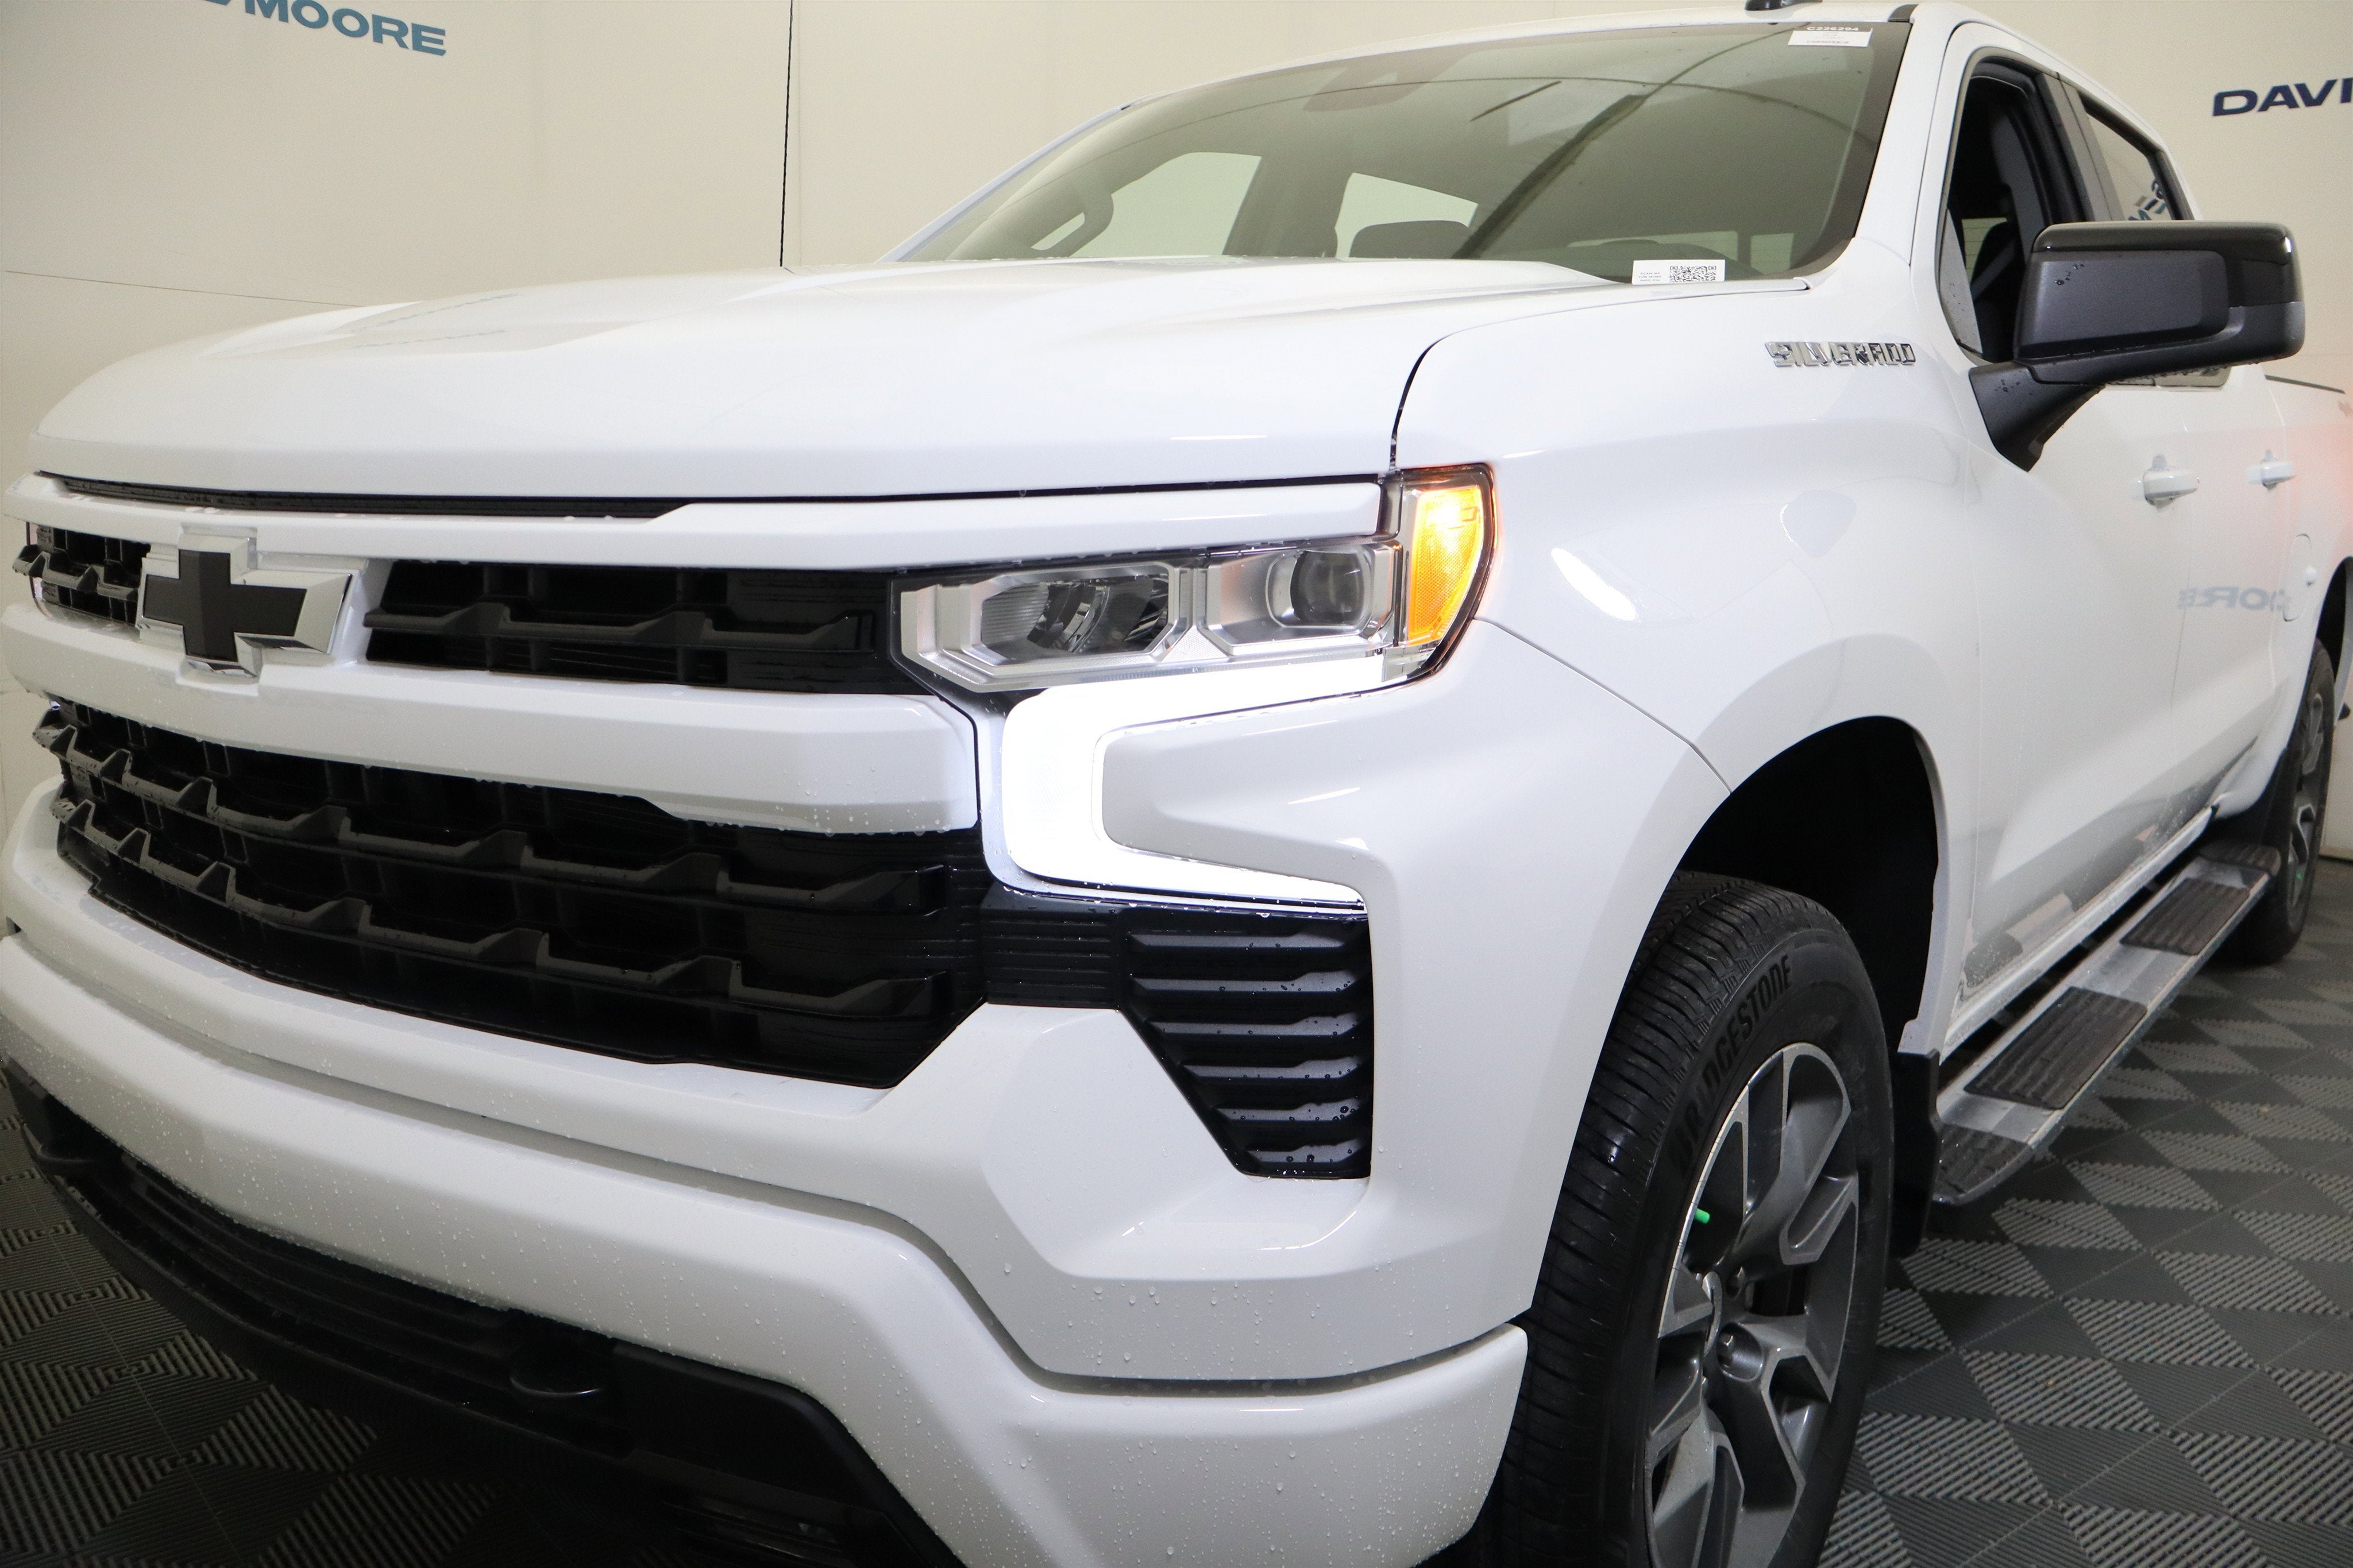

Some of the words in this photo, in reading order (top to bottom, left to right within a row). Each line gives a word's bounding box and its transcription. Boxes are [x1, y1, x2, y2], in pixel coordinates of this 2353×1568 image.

[245, 0, 446, 56] MOORE
[2212, 77, 2353, 116] DAVI
[1765, 342, 1916, 368] SILVERADO
